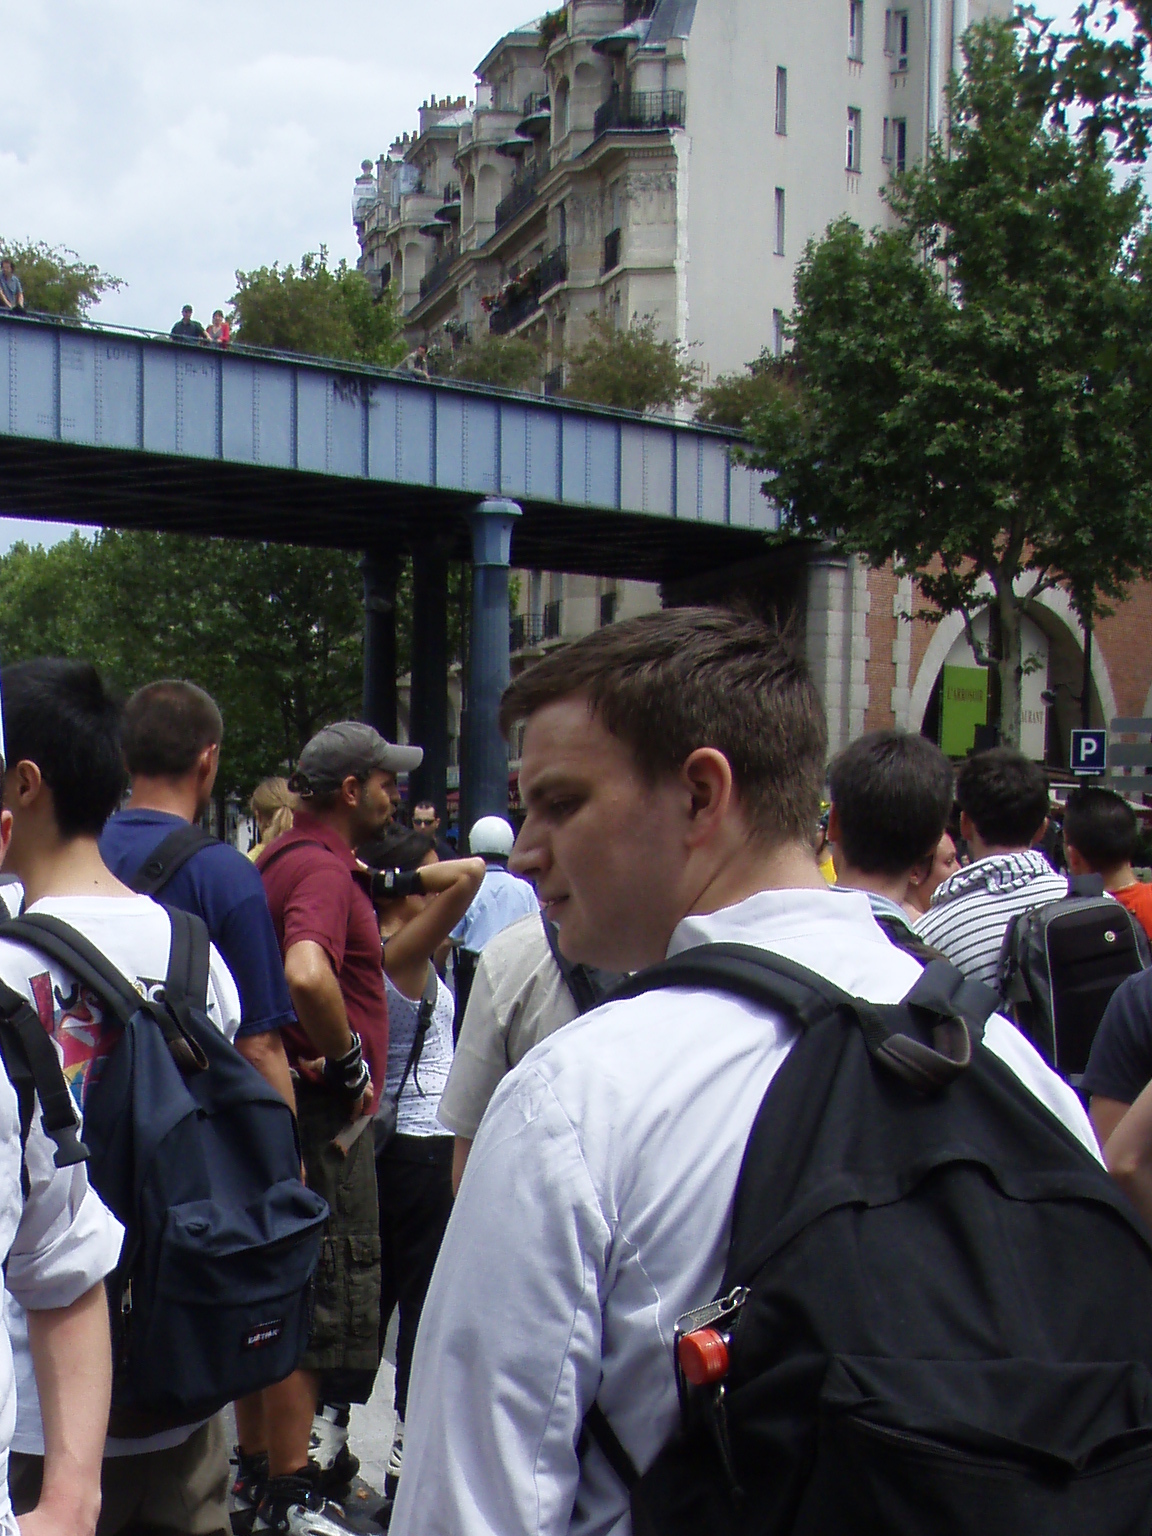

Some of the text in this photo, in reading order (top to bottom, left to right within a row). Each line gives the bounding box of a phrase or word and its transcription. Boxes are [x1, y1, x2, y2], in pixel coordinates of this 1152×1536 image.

[1021, 709, 1044, 725] AURANT
[1079, 737, 1098, 762] P
[247, 1328, 280, 1345] EASTPAK
